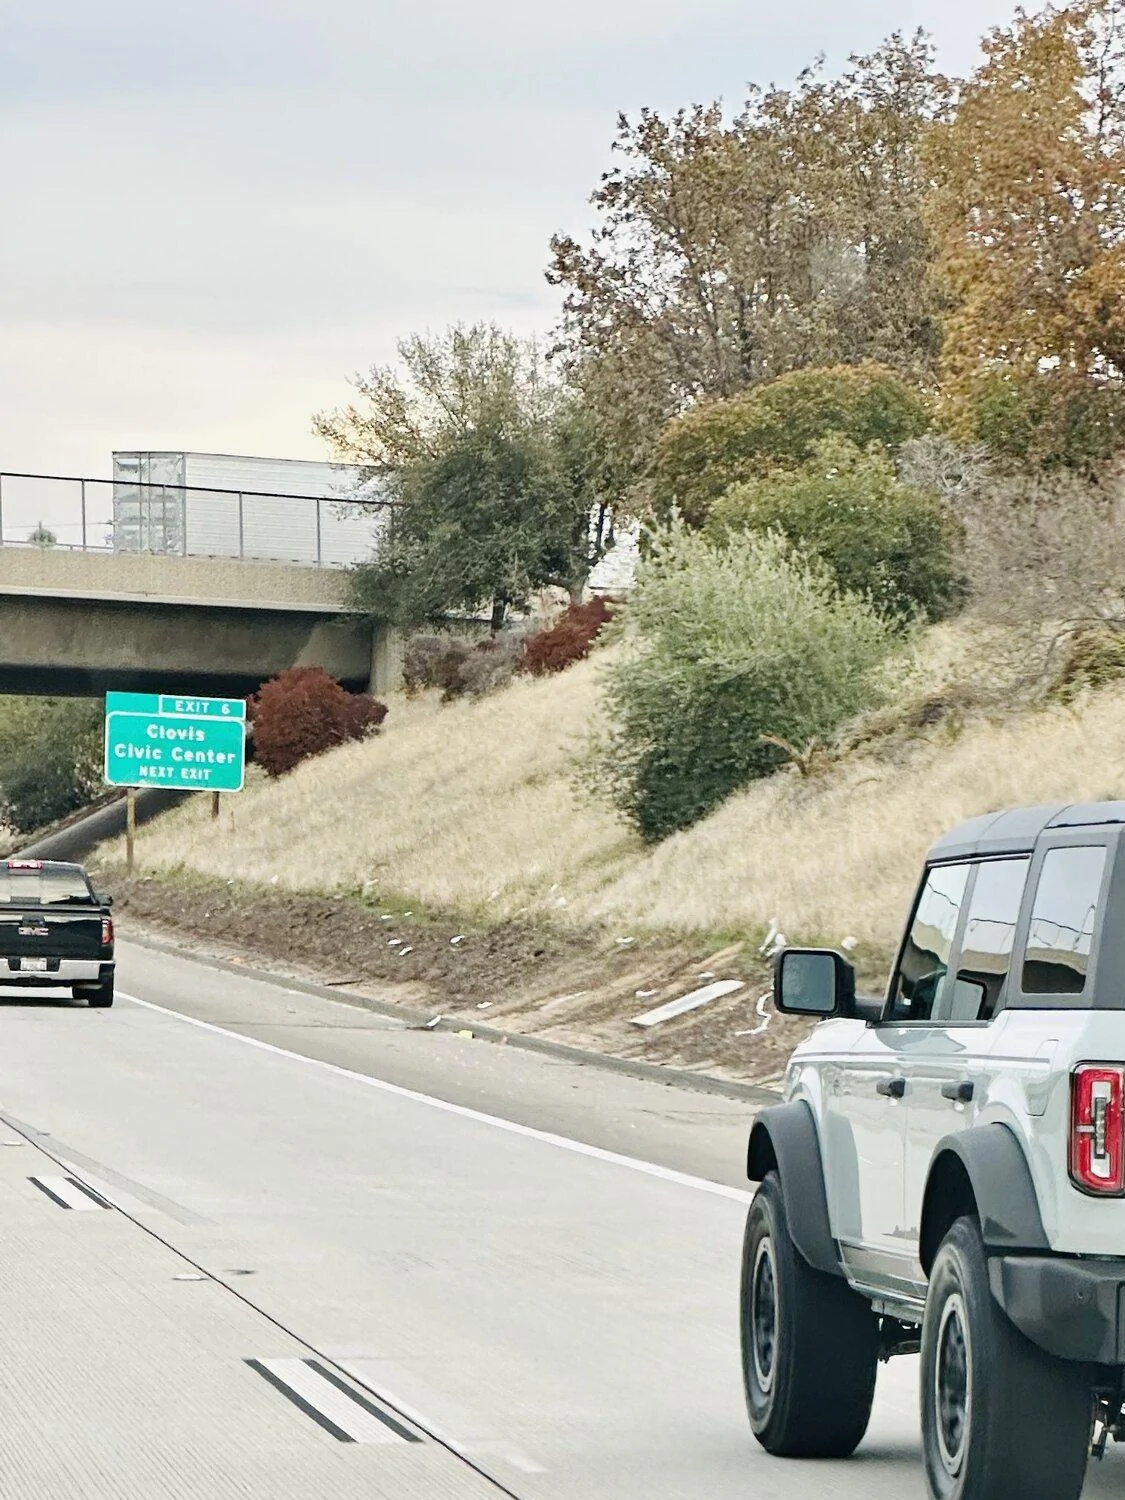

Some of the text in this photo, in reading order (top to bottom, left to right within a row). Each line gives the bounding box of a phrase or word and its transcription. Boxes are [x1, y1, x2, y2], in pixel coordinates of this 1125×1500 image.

[175, 700, 231, 715] EXIT 6
[146, 723, 206, 742] Clovis
[114, 743, 237, 764] Civic Center
[139, 765, 213, 781] NEXT EXIT
